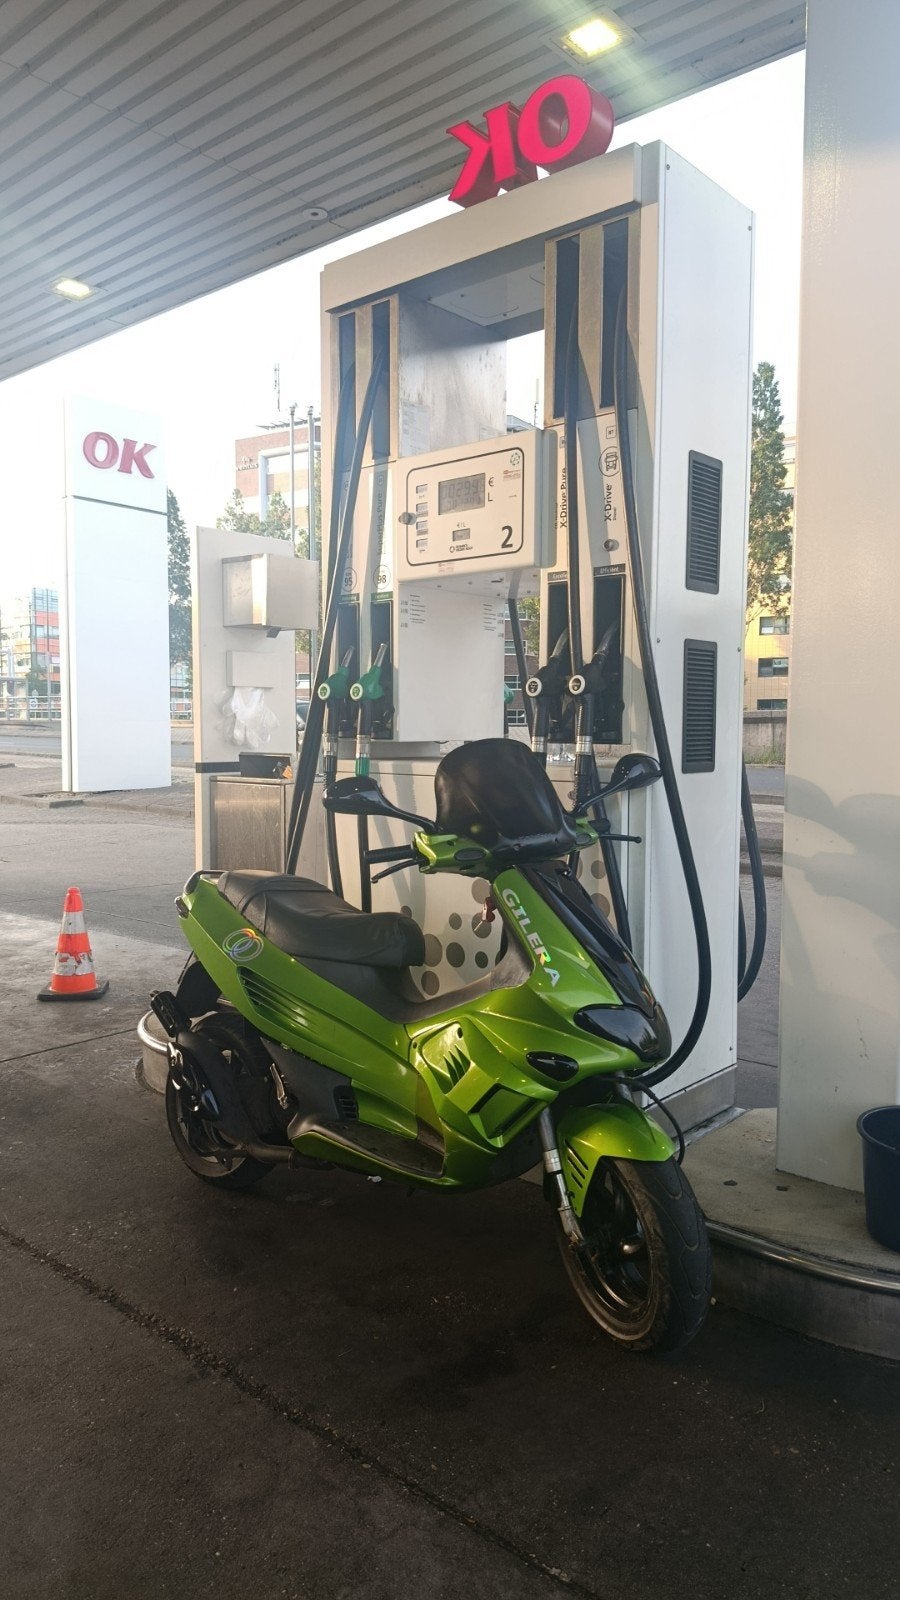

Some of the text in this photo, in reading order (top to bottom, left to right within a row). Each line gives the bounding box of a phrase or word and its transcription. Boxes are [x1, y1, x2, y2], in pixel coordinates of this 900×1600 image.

[82, 431, 157, 479] OK
[488, 476, 495, 487] €
[487, 492, 494, 502] L
[501, 525, 513, 549] 2
[344, 577, 353, 587] 95
[377, 574, 387, 584] 98
[501, 888, 561, 987] GILERA
